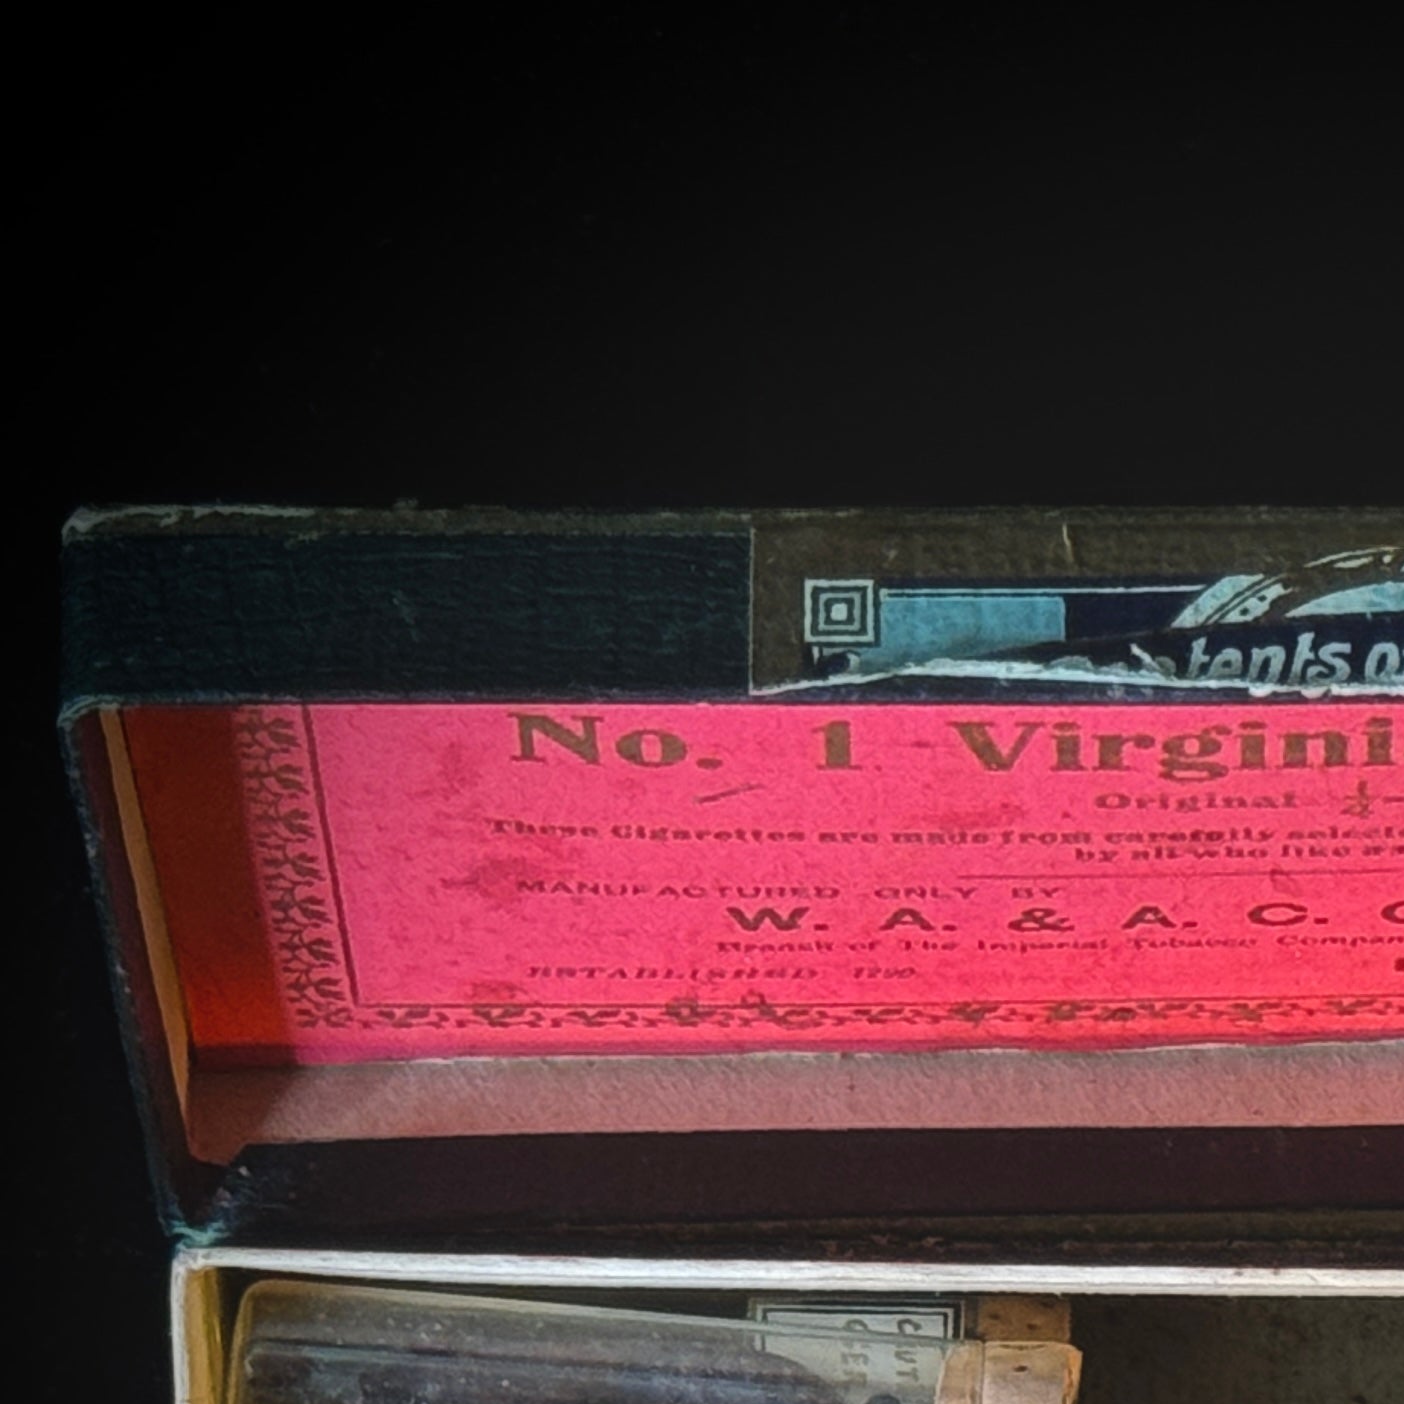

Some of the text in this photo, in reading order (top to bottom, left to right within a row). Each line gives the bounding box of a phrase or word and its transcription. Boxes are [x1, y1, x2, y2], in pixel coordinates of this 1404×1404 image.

[508, 713, 724, 769] No.
[812, 720, 863, 772] 1
[1094, 791, 1298, 813] Original
[484, 819, 599, 838] These
[610, 824, 805, 843] Cigarettes
[817, 831, 879, 844] are
[891, 829, 990, 845] made
[1001, 829, 1091, 846] from
[1104, 826, 1274, 843] carefully
[1074, 847, 1120, 862] by
[515, 879, 1062, 900] MANUFACTURED ONLY BY
[725, 906, 830, 932] W.
[878, 907, 958, 932] A.
[1007, 907, 1075, 932] &
[1120, 905, 1198, 930] A.
[1246, 902, 1329, 927] C.
